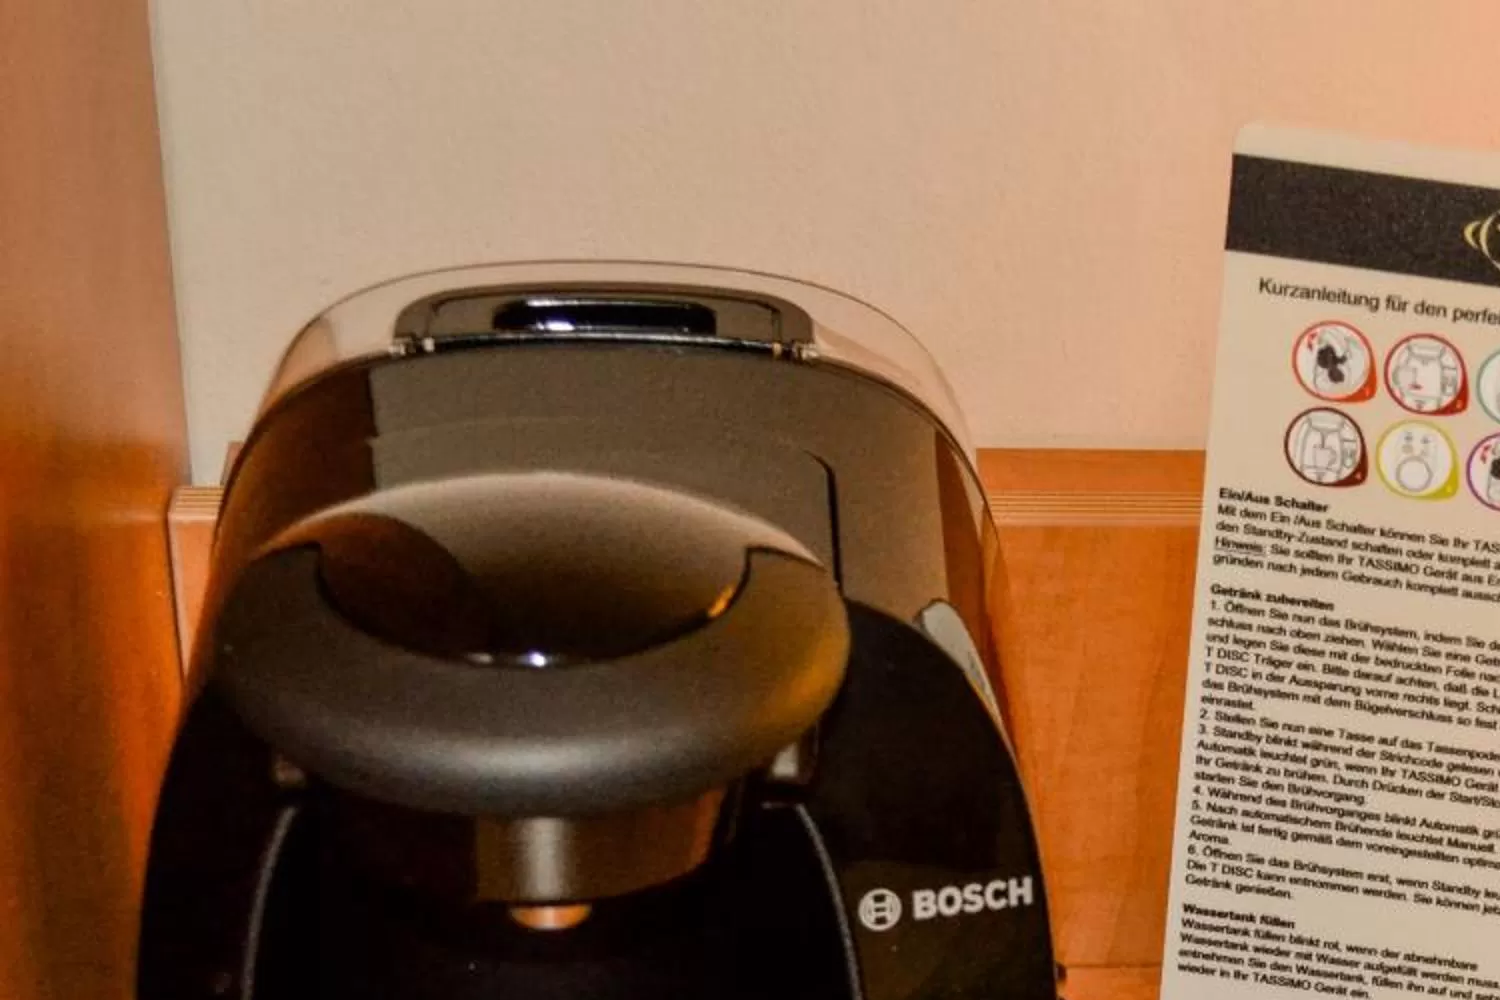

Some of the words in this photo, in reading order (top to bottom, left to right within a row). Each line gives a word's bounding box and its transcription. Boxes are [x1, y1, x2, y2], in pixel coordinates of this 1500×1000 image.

[1258, 276, 1380, 309] Kurzanleitung
[1384, 294, 1410, 313] für
[1412, 299, 1447, 318] den
[1218, 486, 1271, 505] Ein/Aus
[1273, 495, 1330, 513] Schalter
[912, 876, 1033, 921] BOSCH
[1181, 902, 1257, 924] Wassertank
[1259, 913, 1296, 930] füllen
